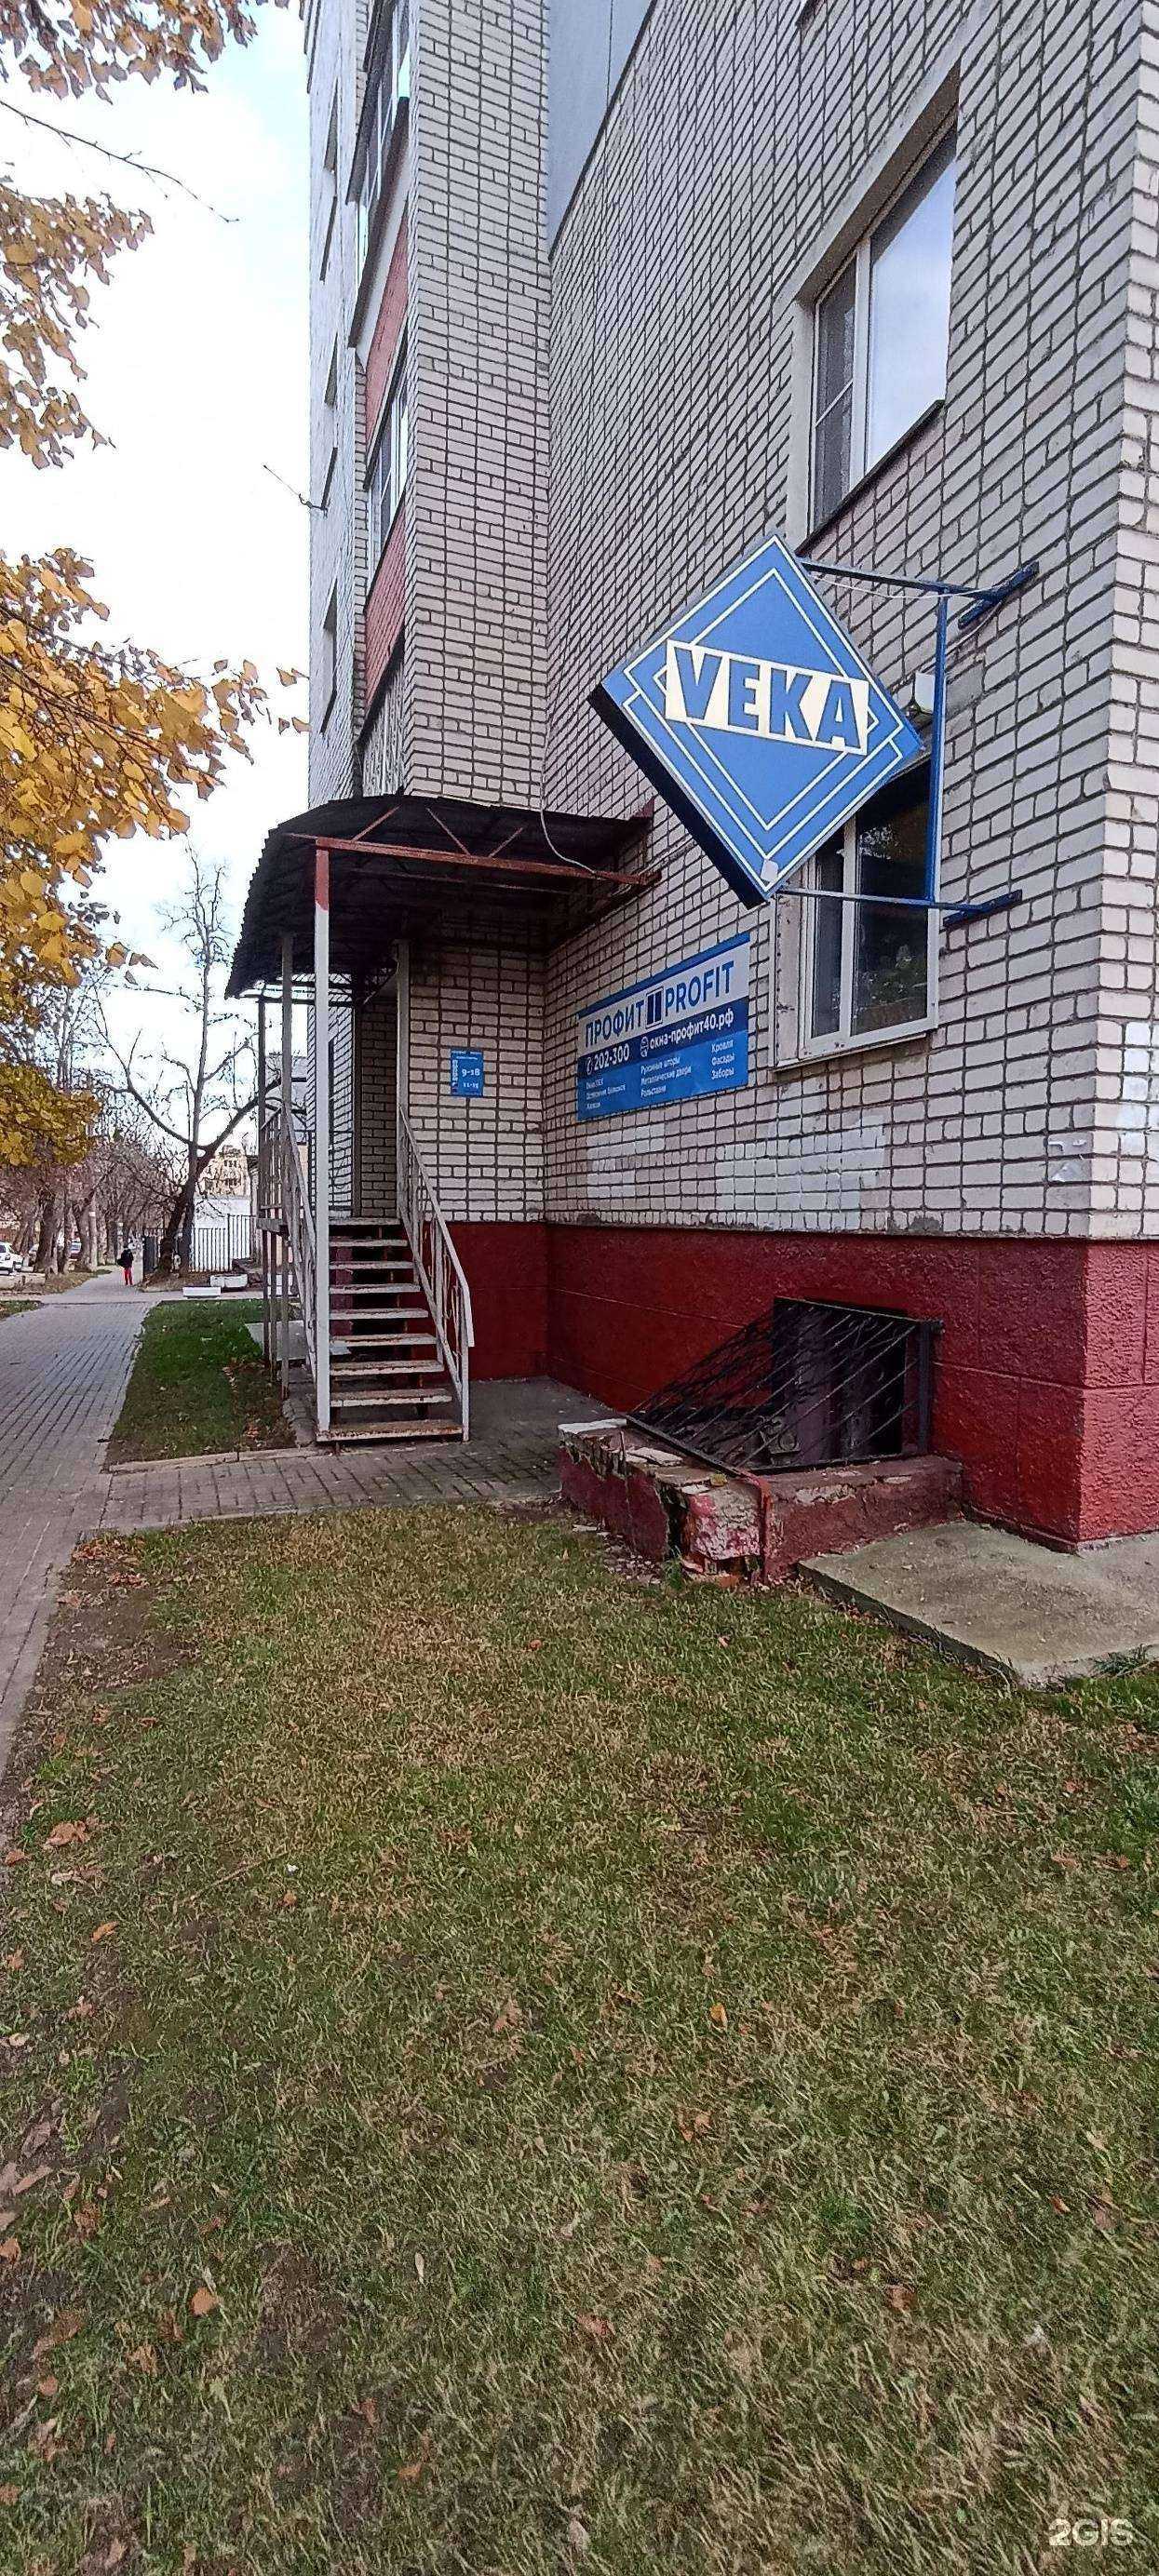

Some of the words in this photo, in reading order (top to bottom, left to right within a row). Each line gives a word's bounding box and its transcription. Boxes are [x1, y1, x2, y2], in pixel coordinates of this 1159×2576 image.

[673, 647, 861, 747] VEKA
[665, 960, 734, 1016] PROFIT
[585, 1000, 645, 1048] ПРОФИТ
[649, 1008, 734, 1050] окна-профит40.рф
[711, 1067, 734, 1080] Заборы
